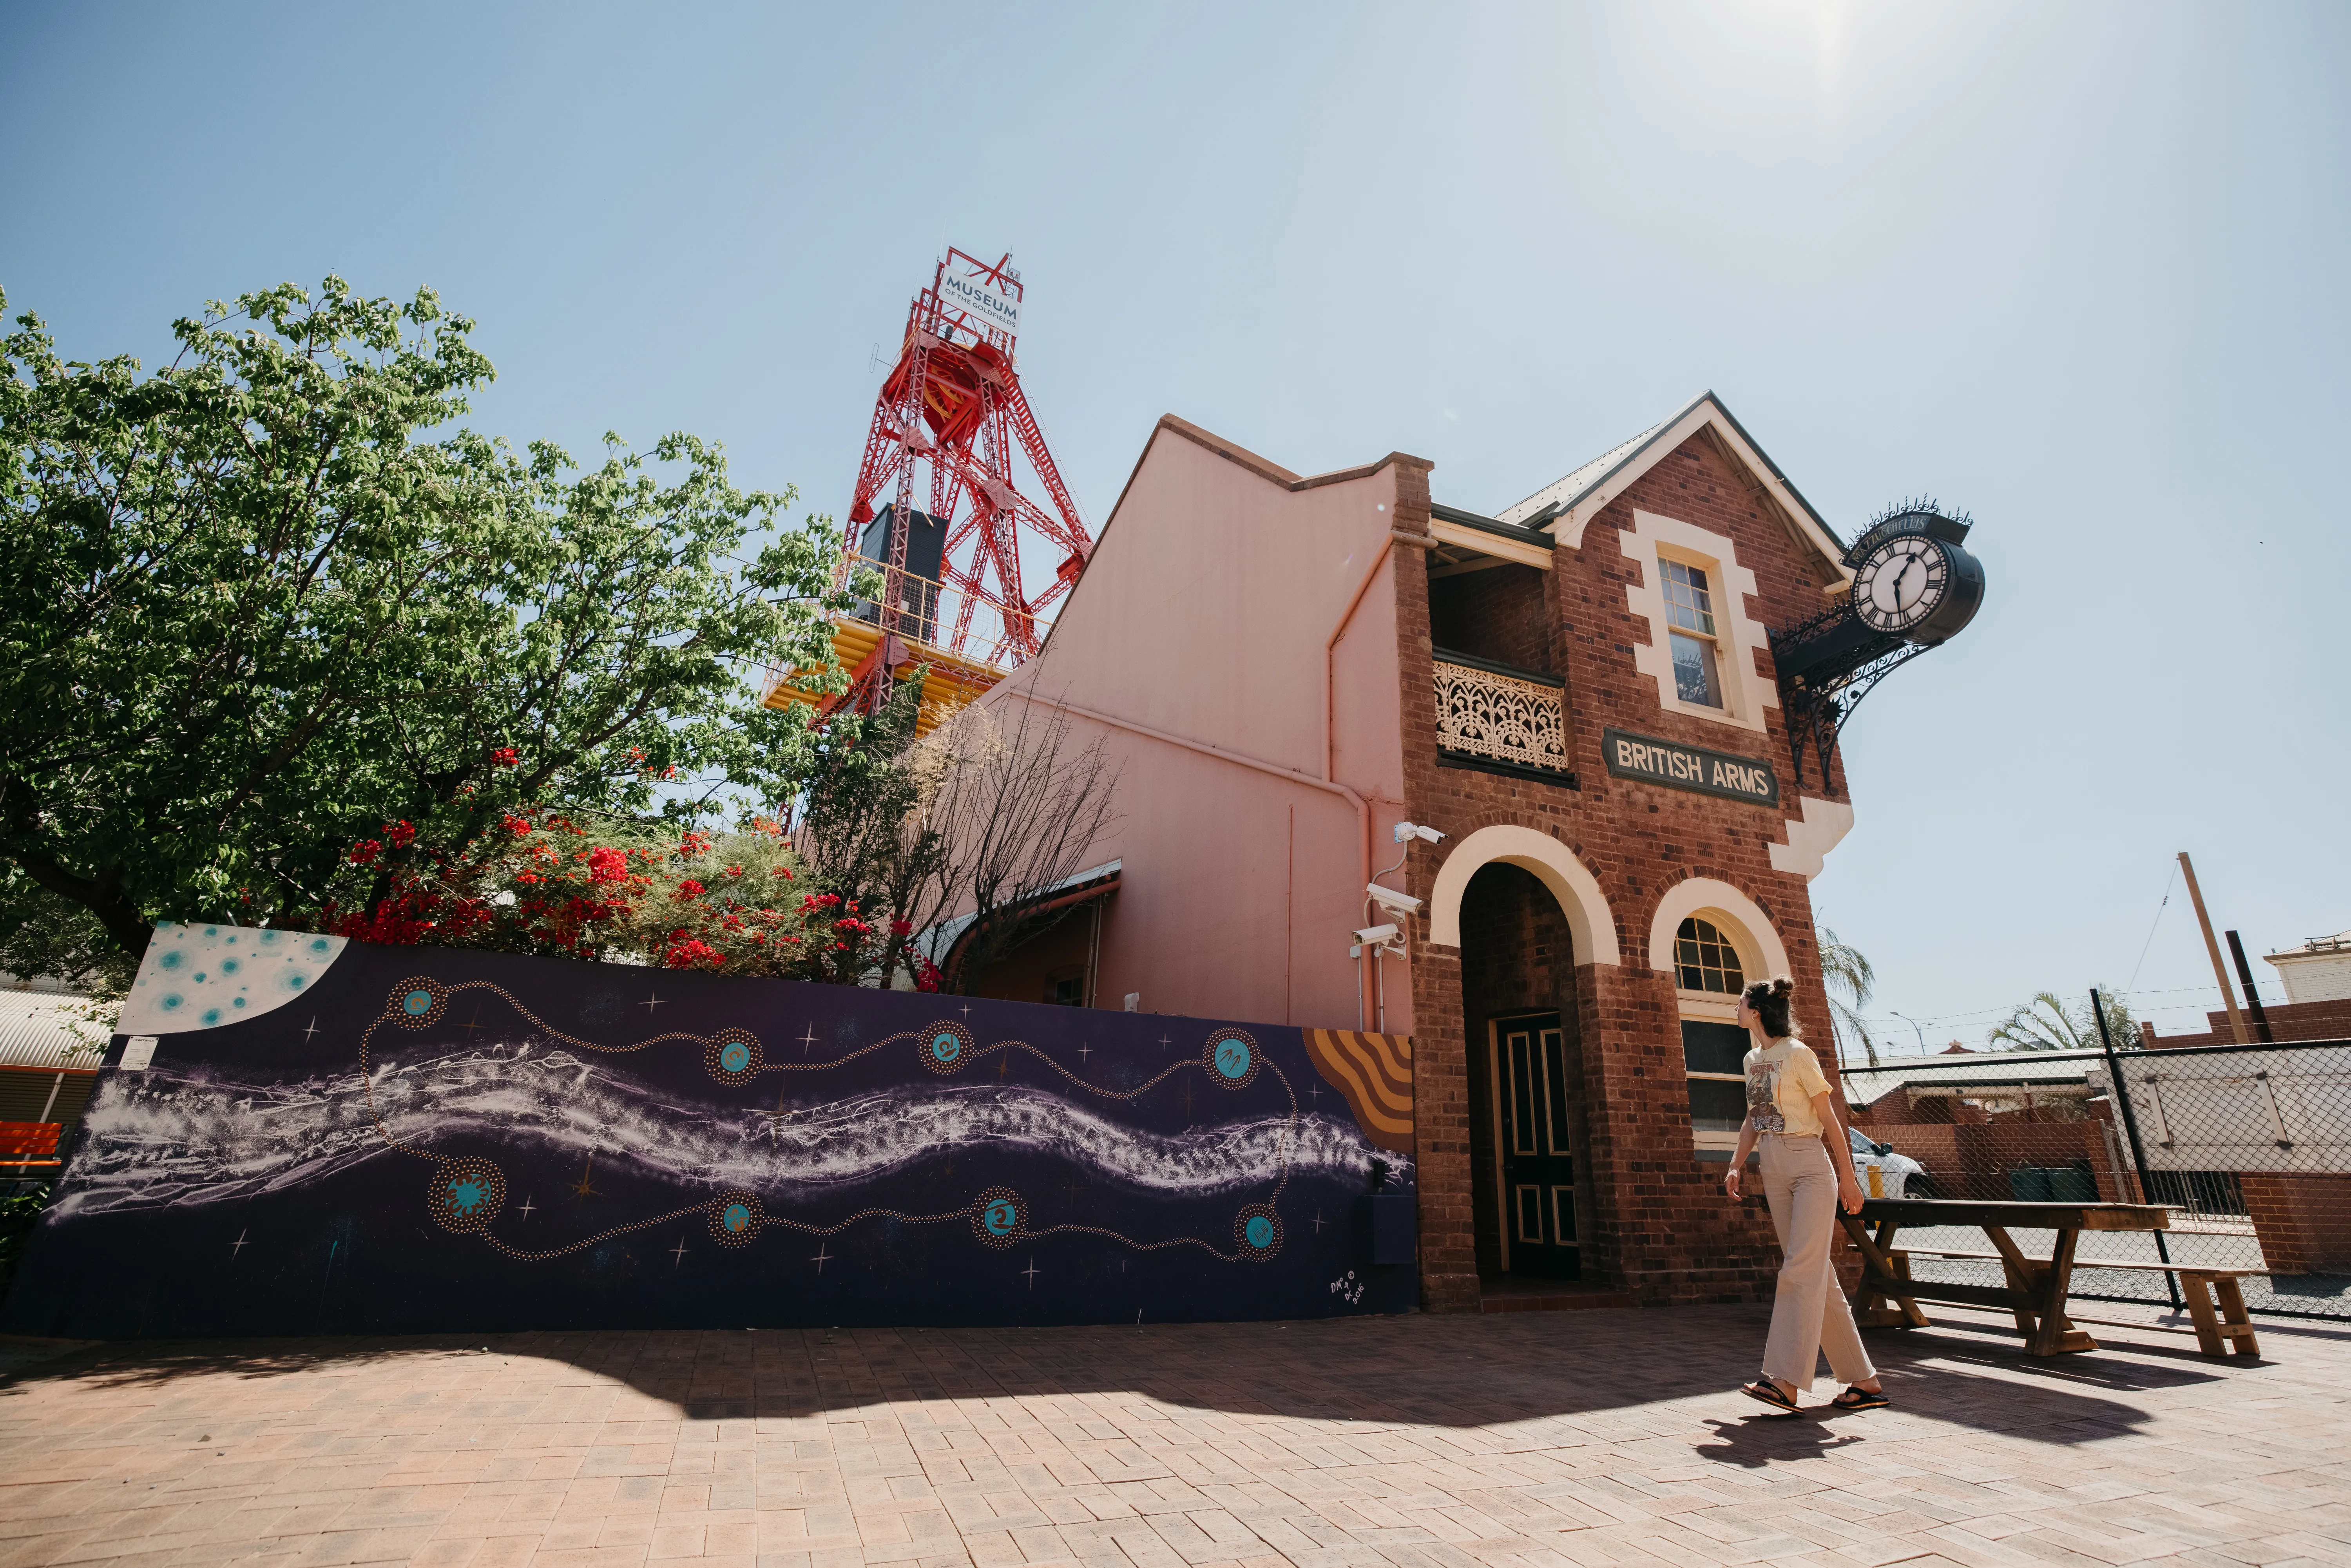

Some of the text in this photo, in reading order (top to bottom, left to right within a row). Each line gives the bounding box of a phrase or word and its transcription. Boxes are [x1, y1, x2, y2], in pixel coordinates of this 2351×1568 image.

[946, 275, 1016, 320] MUSEUM
[957, 294, 971, 304] THE
[973, 302, 1016, 328] GOLDFIELDS
[1617, 740, 1769, 795] BRITISH ARMS
[1353, 1283, 1364, 1304] 2016
